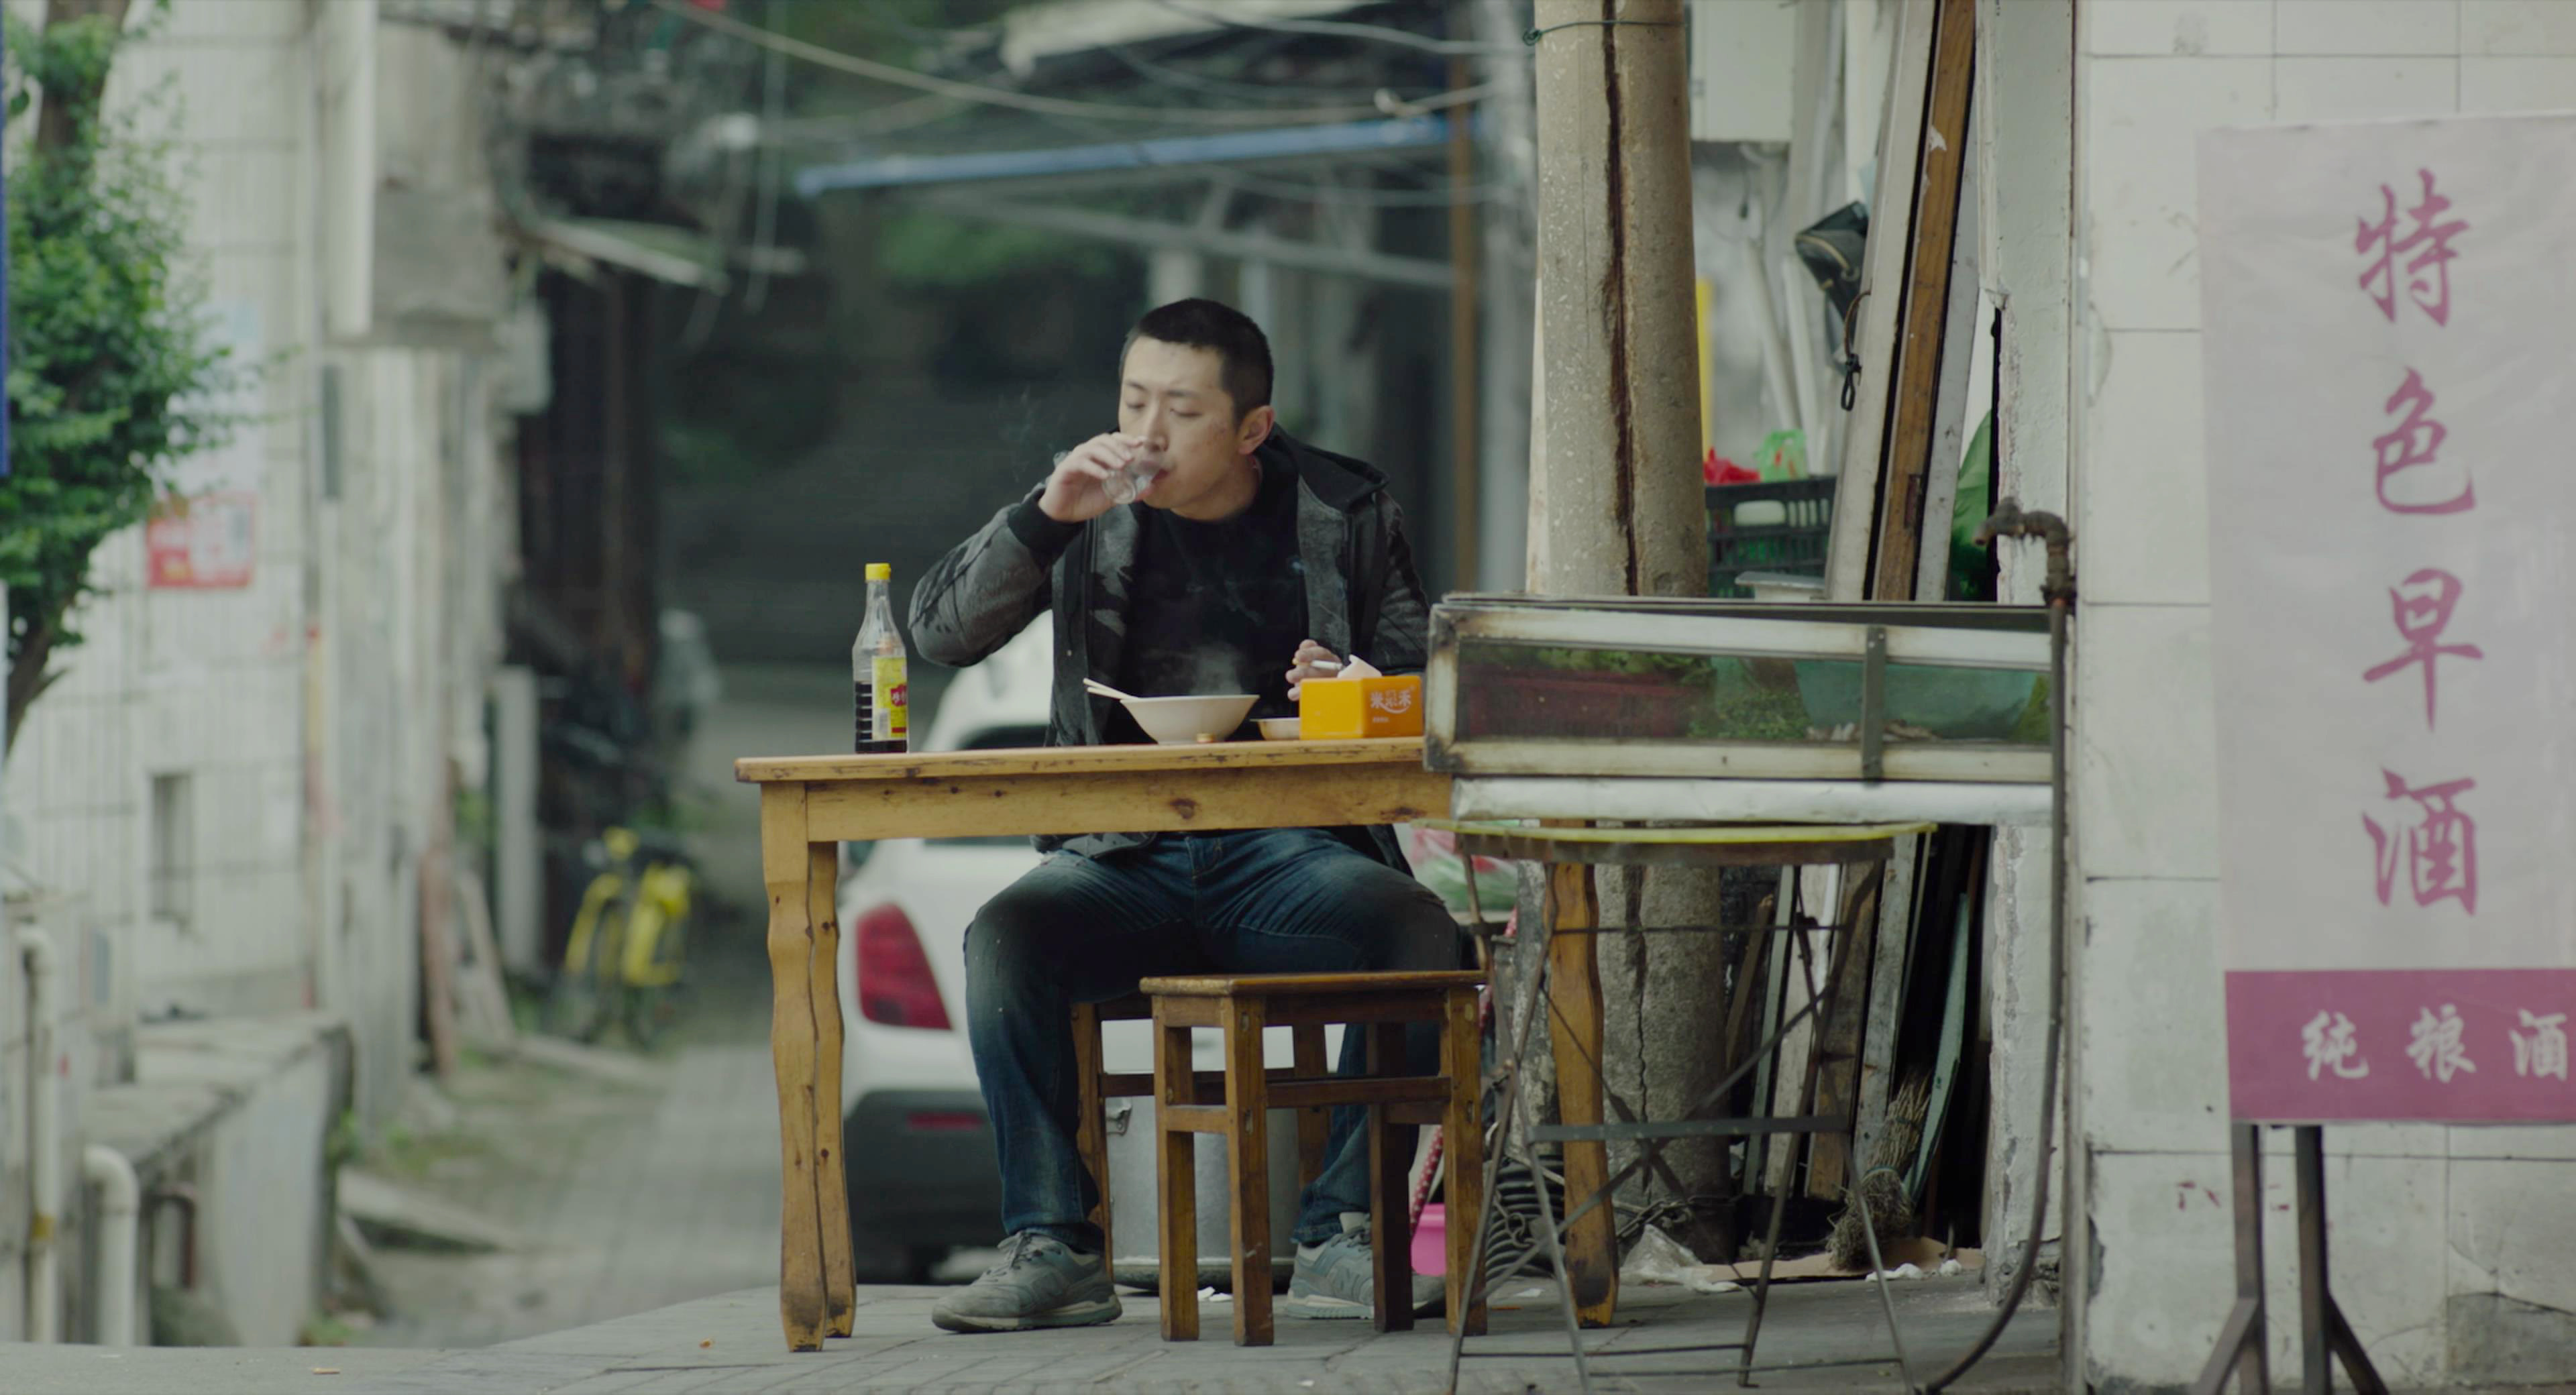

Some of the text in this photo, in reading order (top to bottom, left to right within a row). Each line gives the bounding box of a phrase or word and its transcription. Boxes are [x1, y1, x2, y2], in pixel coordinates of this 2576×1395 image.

[2355, 168, 2483, 915] 特色早酒
[2301, 1005, 2569, 1082] 纯粮酒
